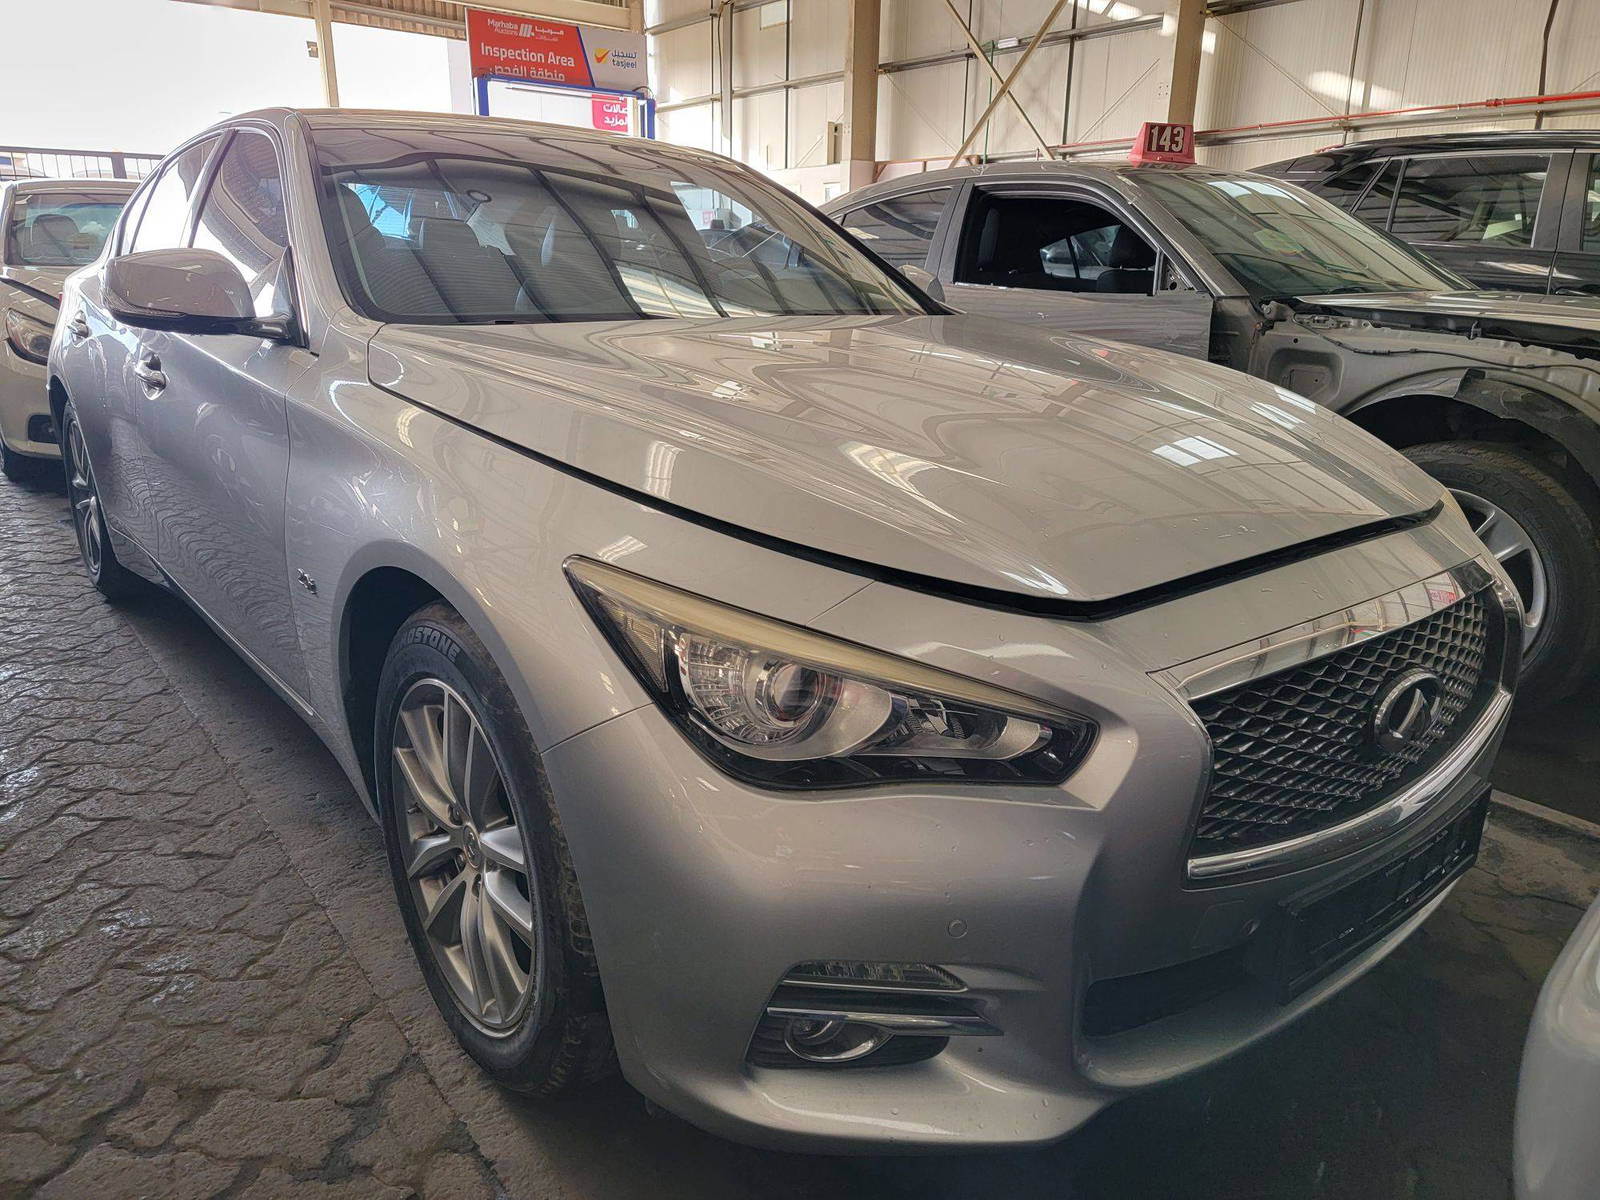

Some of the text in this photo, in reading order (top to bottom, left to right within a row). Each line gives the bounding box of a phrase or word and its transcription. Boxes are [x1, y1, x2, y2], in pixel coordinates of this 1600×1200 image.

[487, 18, 519, 31] Marhaba
[481, 42, 575, 67] Inspection Area
[611, 49, 638, 59] تسجيل
[612, 58, 637, 69] tasjeel
[530, 66, 566, 82] منطقة
[1151, 125, 1184, 152] 143
[389, 626, 460, 663] DSTONE
